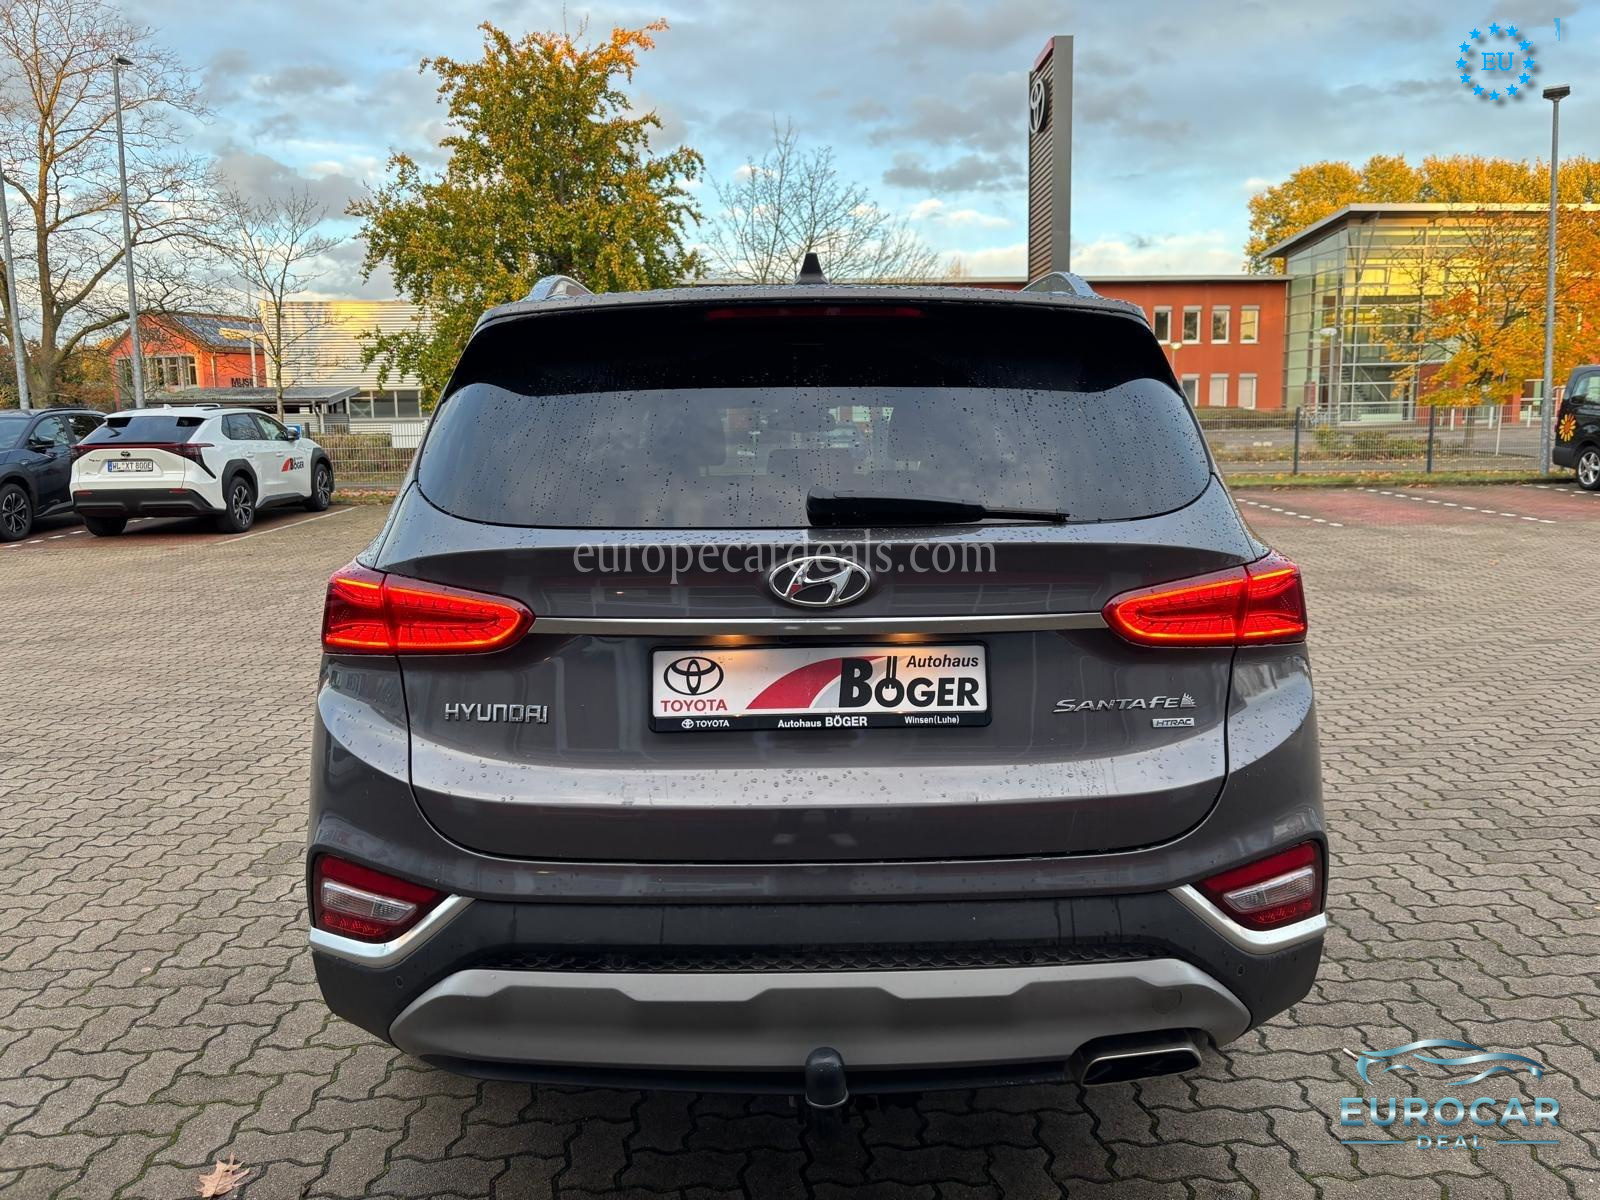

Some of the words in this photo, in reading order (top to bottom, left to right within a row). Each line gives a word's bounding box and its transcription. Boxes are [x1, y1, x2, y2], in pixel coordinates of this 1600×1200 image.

[906, 654, 979, 668] Autohaus
[660, 699, 728, 712] TOYOTA
[444, 702, 549, 723] HYUNDAI
[695, 719, 730, 728] TOYOTA
[777, 719, 822, 729] Autohaus
[825, 715, 868, 728] BÖGER
[1154, 719, 1193, 727] HTRAC
